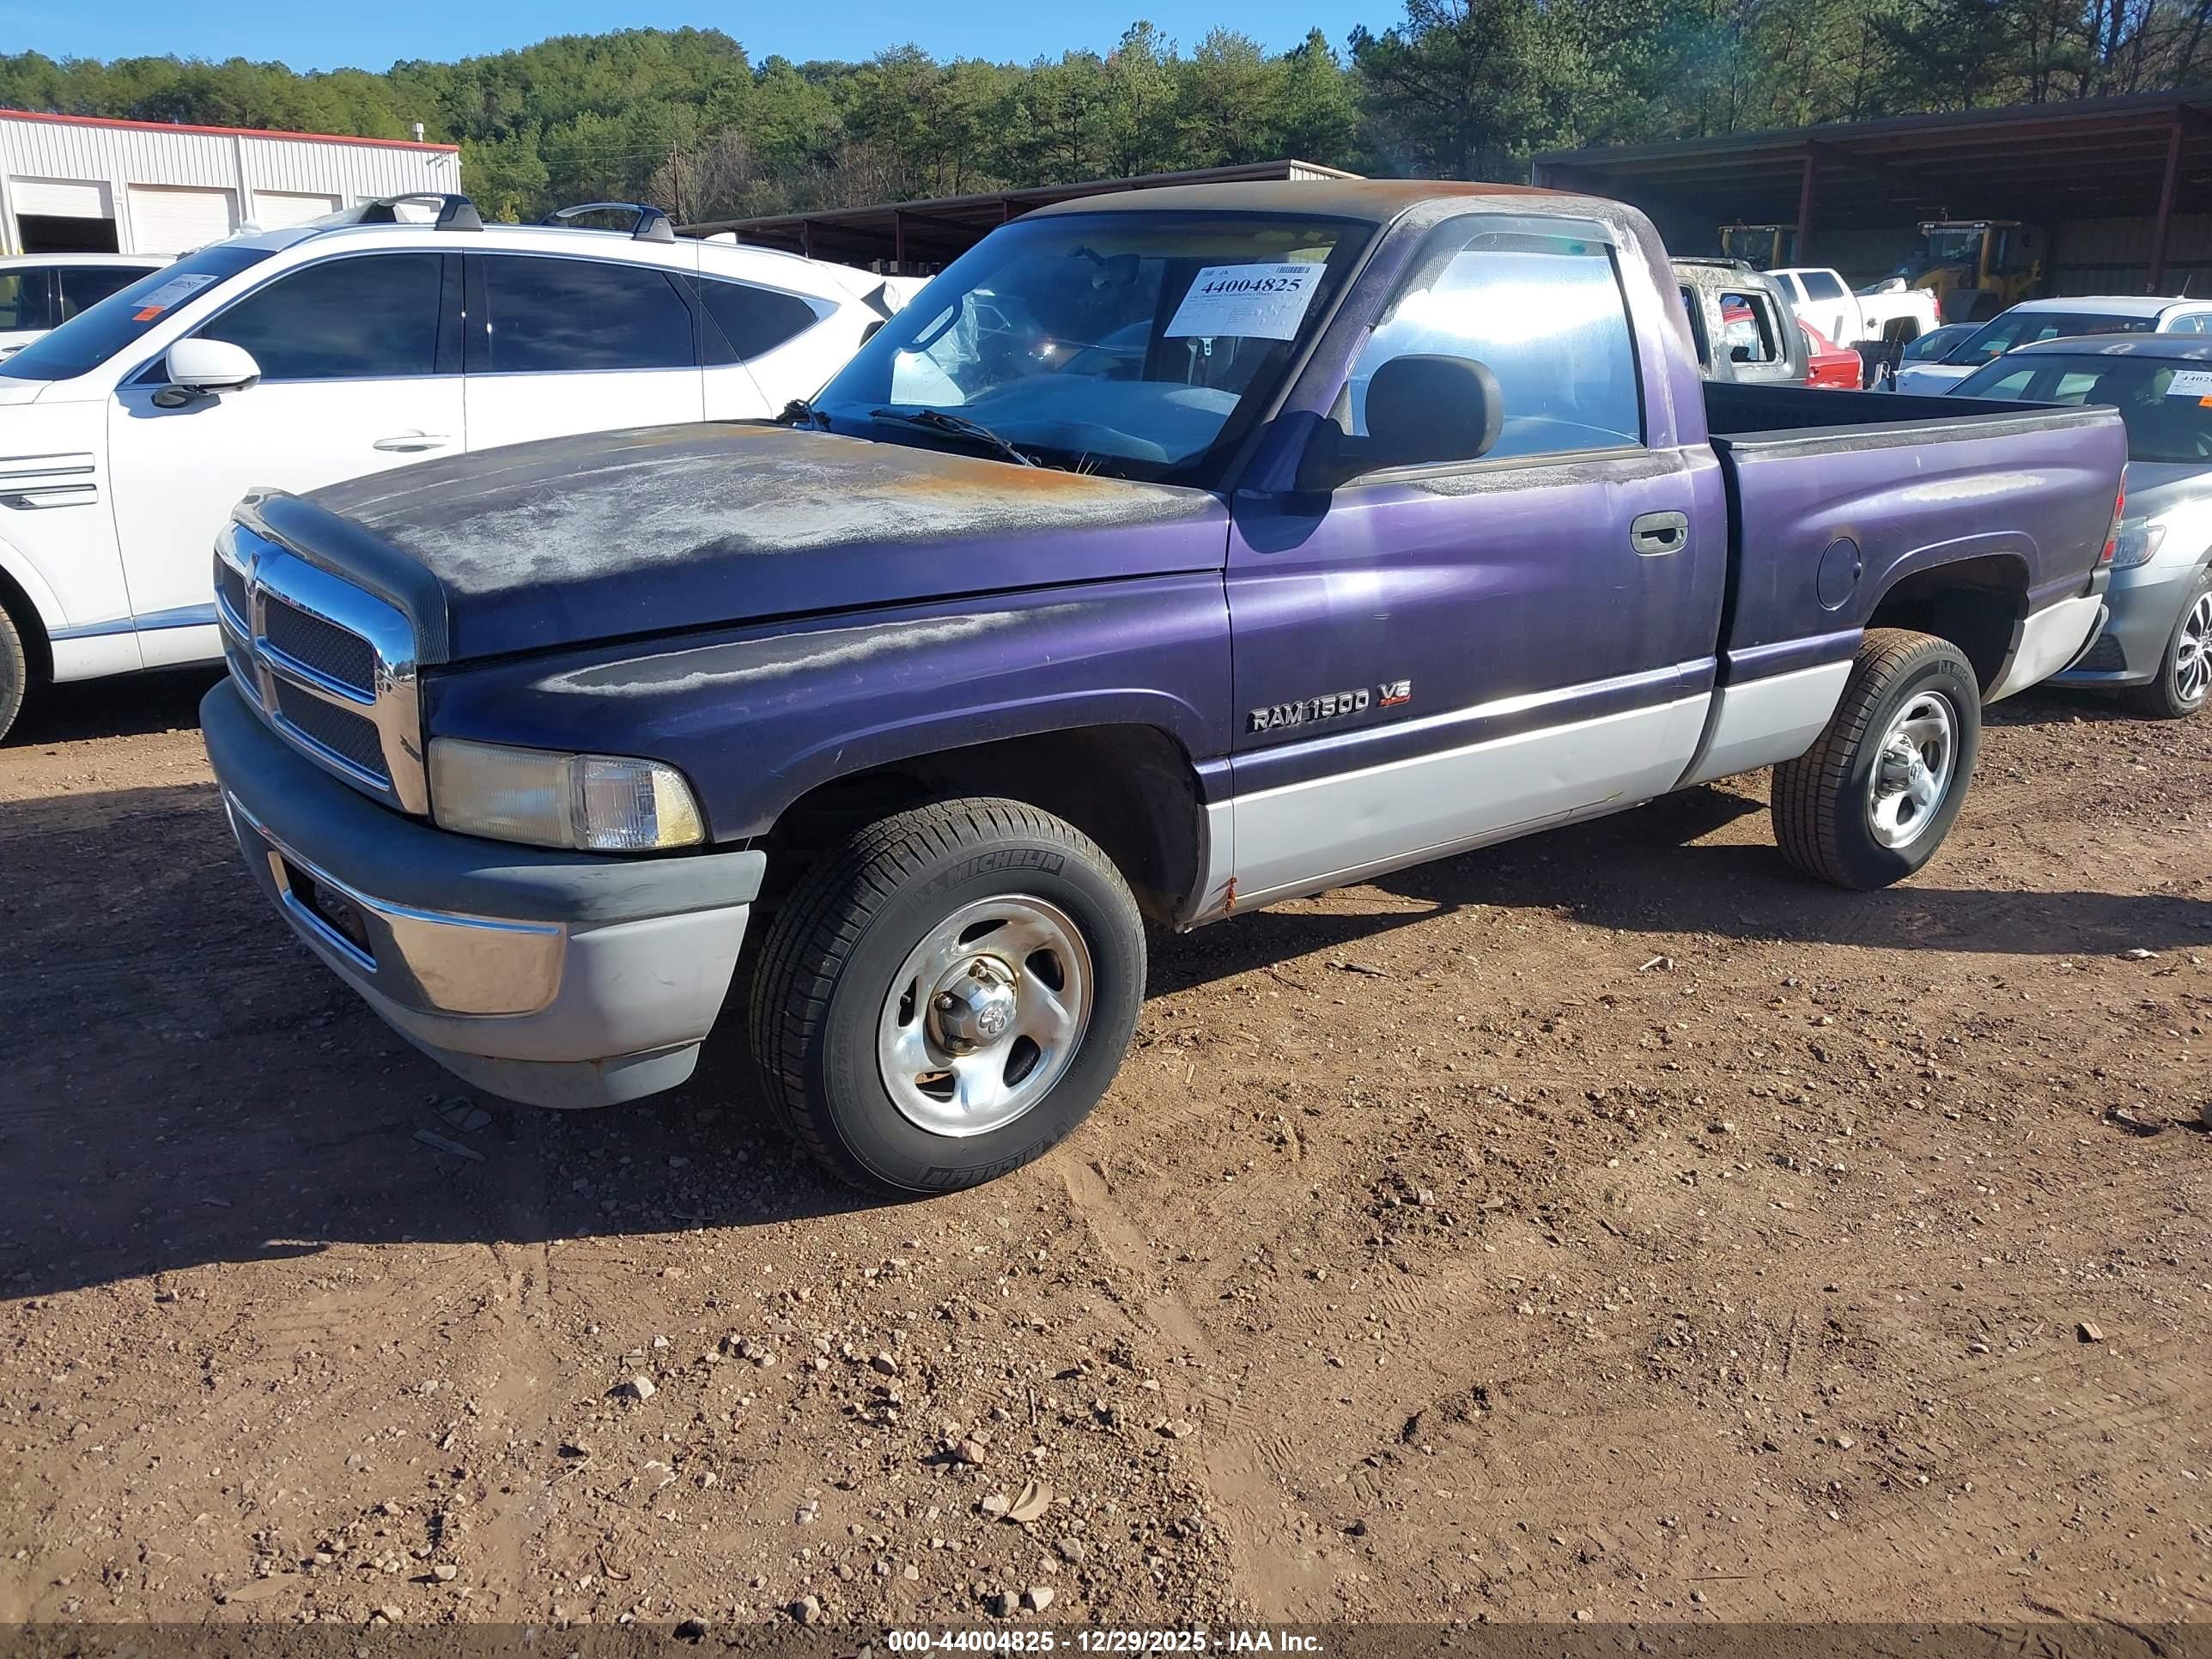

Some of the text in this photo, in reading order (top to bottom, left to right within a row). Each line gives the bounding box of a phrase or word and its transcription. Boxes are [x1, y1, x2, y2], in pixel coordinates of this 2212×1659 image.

[1201, 278, 1303, 294] 44004825
[1250, 701, 1303, 731] RAM
[1306, 688, 1370, 720] 1500
[948, 849, 1065, 887] MICHELIN
[921, 1141, 1044, 1186] MICHELIN
